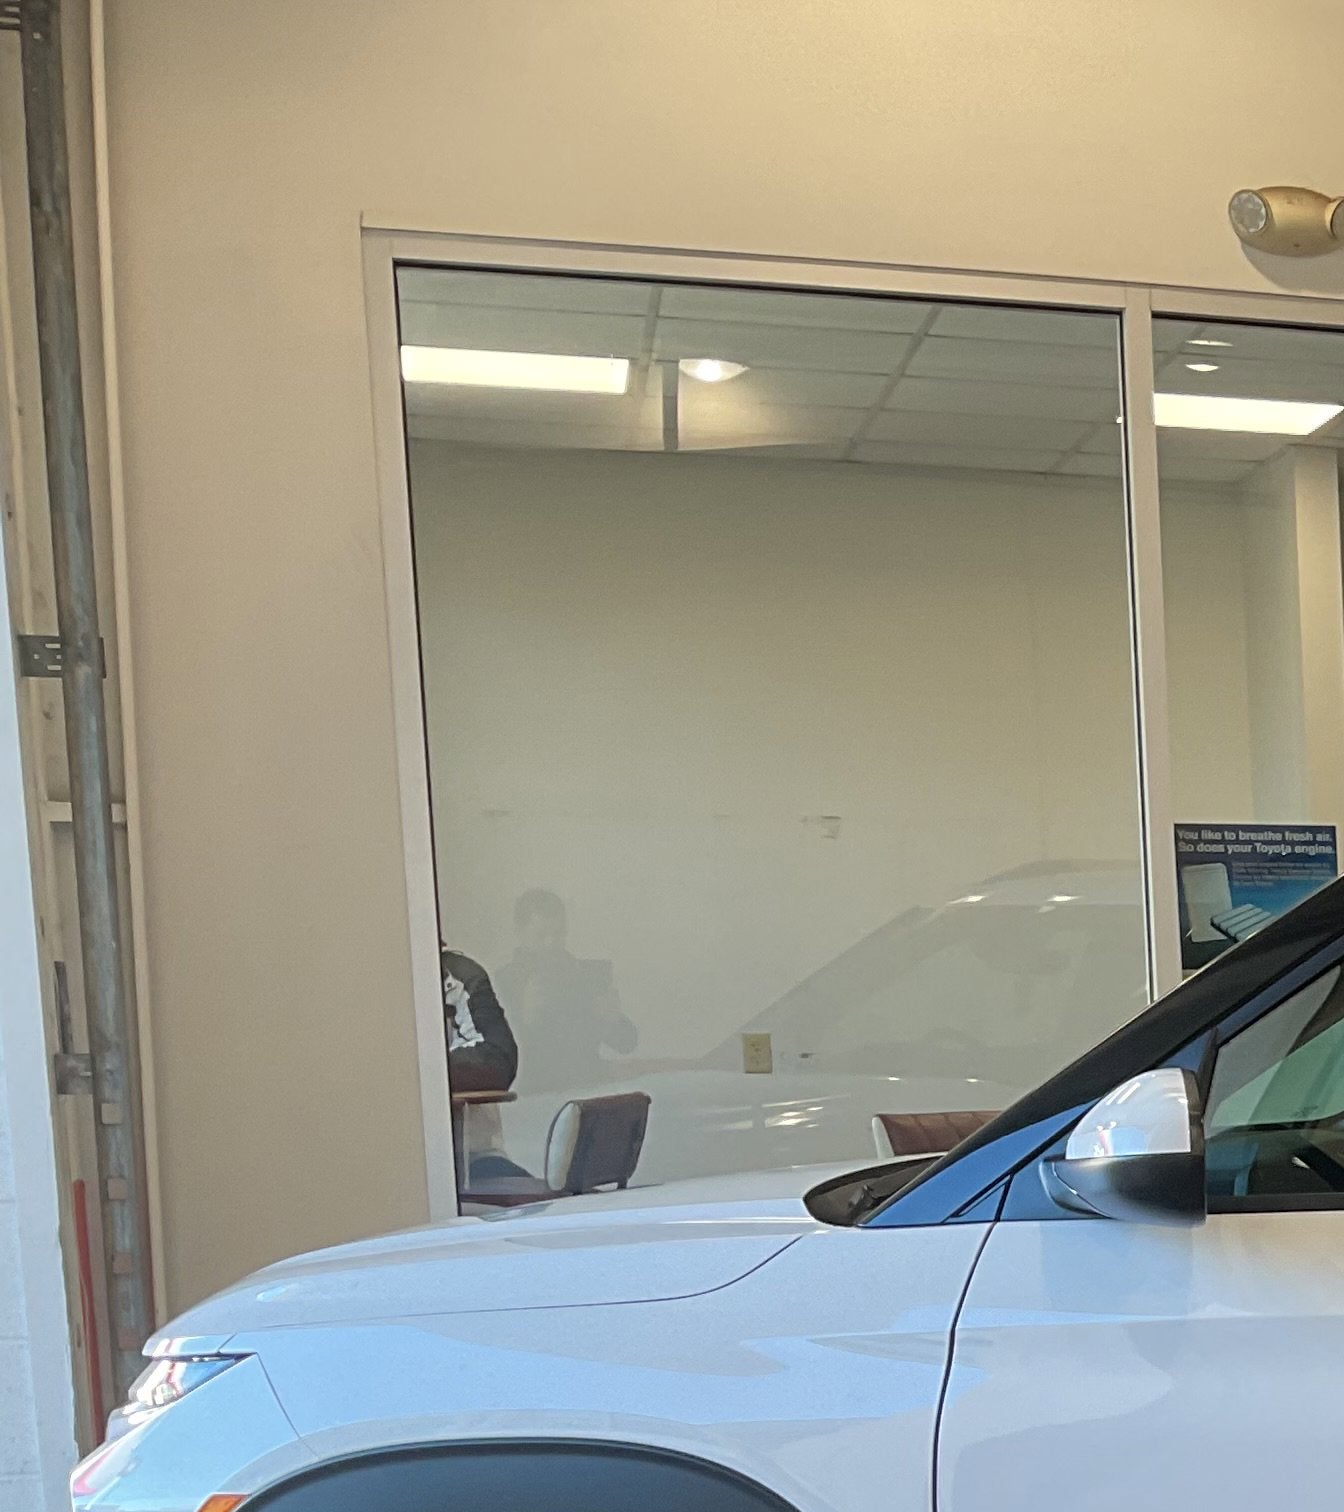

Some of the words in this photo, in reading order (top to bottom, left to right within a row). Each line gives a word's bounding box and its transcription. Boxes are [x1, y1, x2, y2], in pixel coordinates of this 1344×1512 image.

[1177, 829, 1199, 840] You
[1201, 829, 1222, 840] like
[1224, 830, 1236, 841] to
[1238, 830, 1283, 841] breathe
[1285, 831, 1313, 841] fresh
[1178, 841, 1195, 852] So
[1196, 842, 1225, 853] does
[1226, 844, 1253, 855] your
[1254, 842, 1292, 855] Toyota
